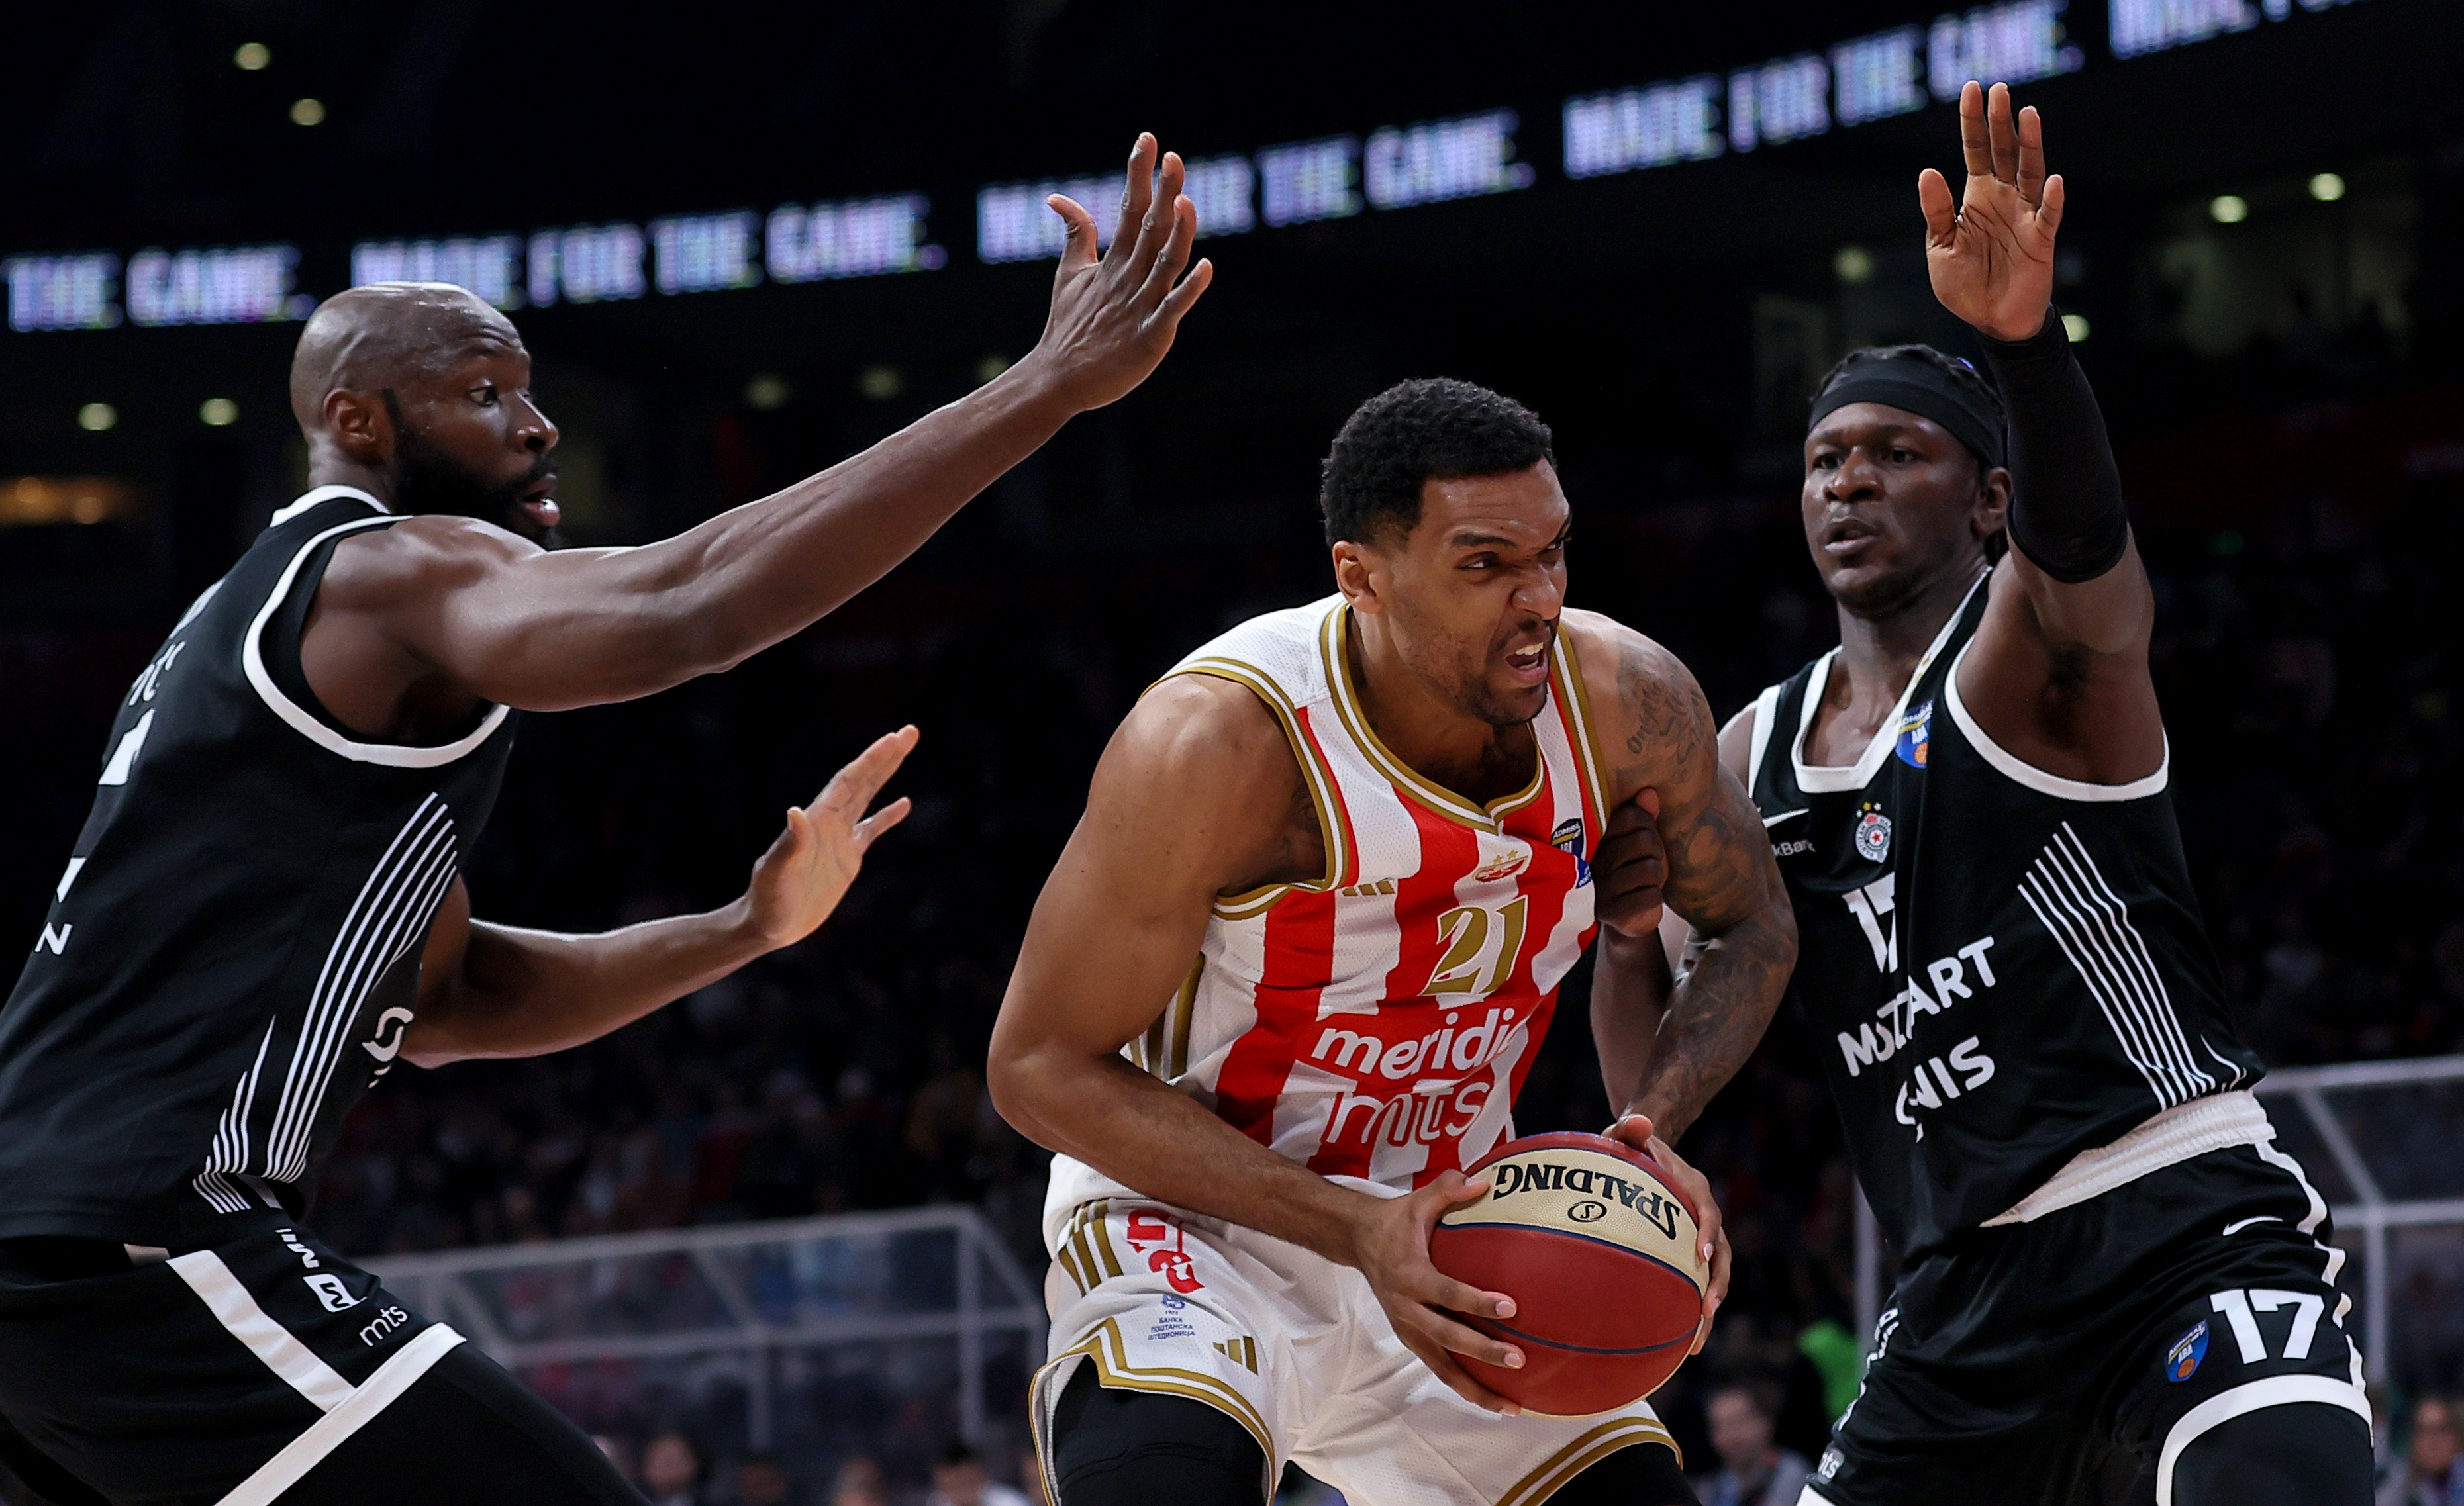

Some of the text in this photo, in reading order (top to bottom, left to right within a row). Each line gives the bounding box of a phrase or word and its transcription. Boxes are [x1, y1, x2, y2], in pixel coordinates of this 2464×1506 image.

[1563, 0, 2085, 179] MADE FOR THE GAME.
[1256, 134, 1365, 228] THE
[1365, 106, 1537, 210] GAME.
[1, 244, 320, 332] THE GAME.
[528, 220, 647, 308] FOR
[647, 211, 763, 295] THE
[765, 190, 948, 283] GAME.
[1418, 894, 1528, 996] 21
[1325, 1080, 1492, 1146] mts
[1493, 1163, 1681, 1241] SPALDING
[358, 1303, 410, 1347] mts
[2210, 1288, 2326, 1365] 17
